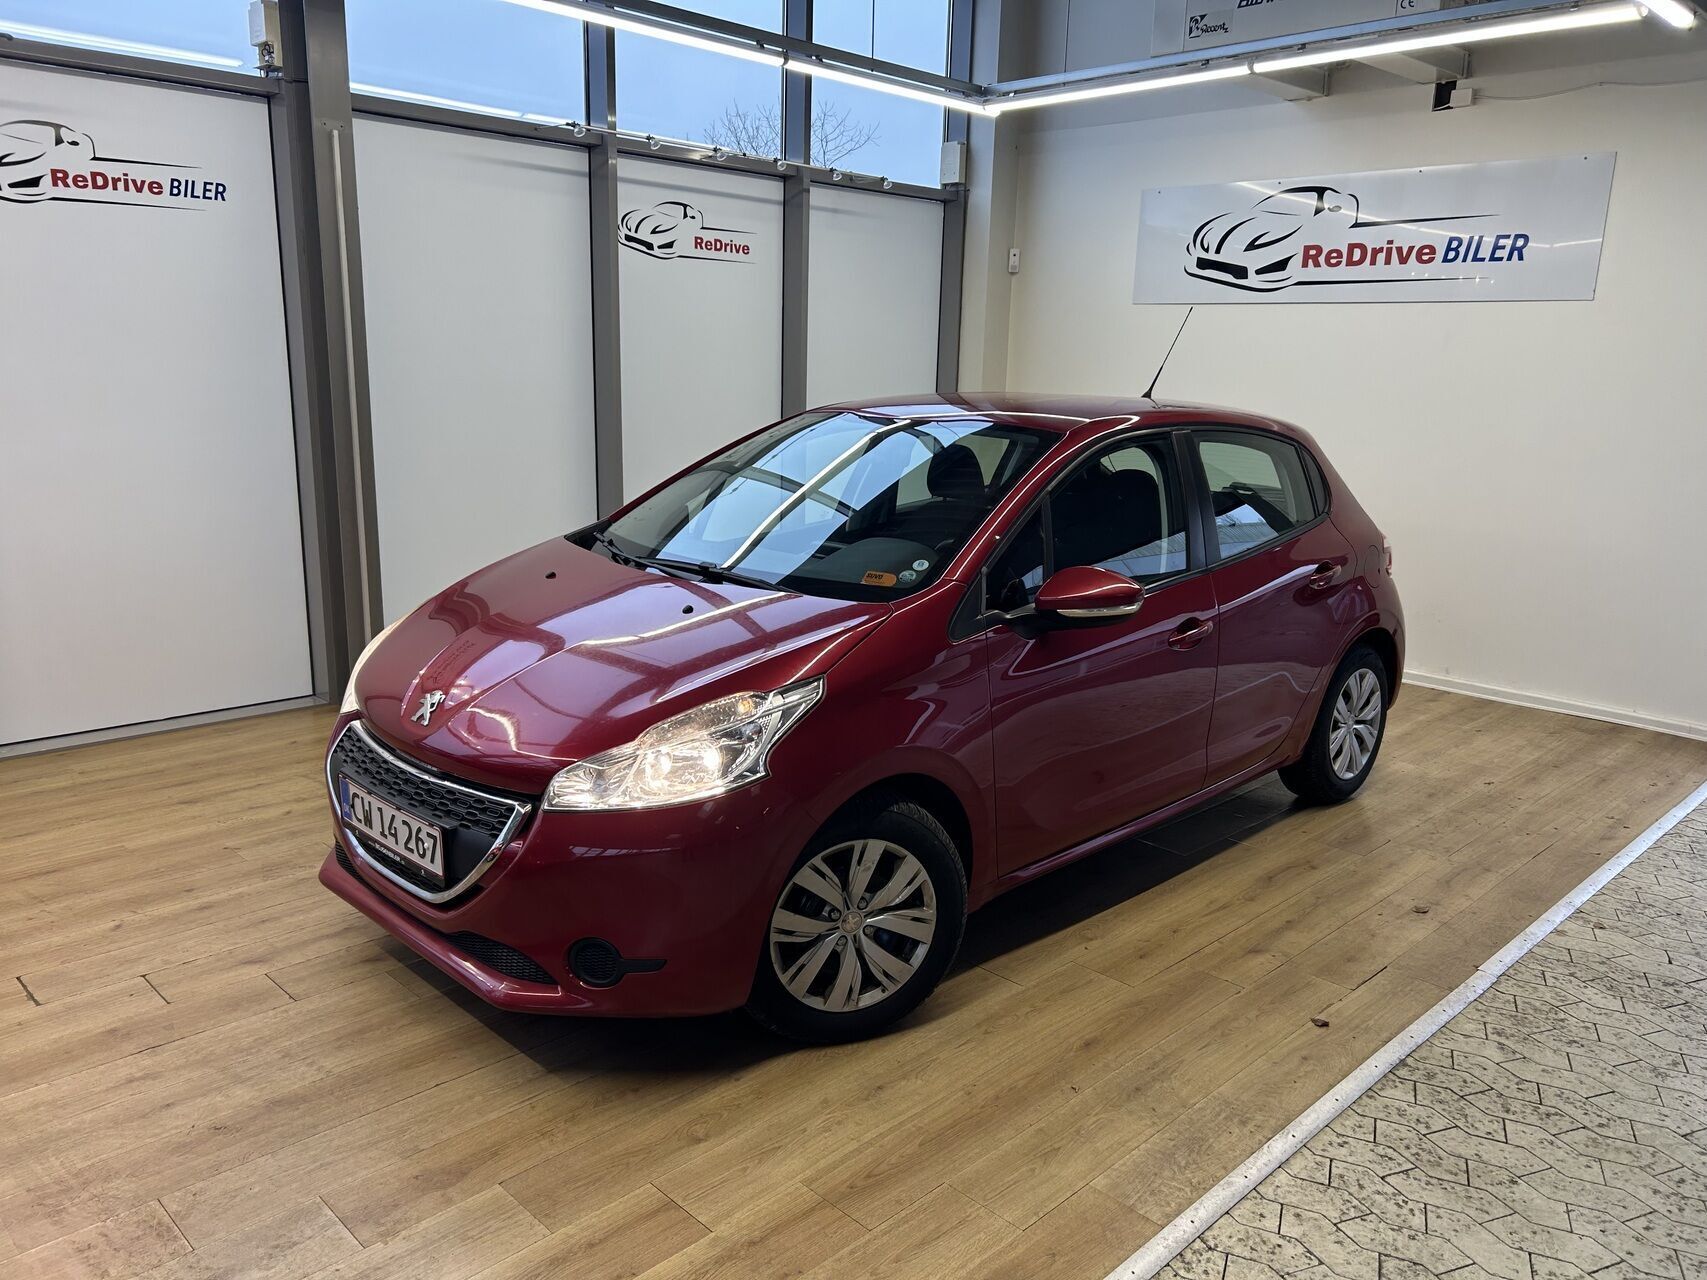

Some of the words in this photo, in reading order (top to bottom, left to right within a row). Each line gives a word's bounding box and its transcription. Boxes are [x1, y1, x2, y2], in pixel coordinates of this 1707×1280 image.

[50, 168, 164, 196] ReDrive
[169, 177, 227, 202] BILER
[694, 236, 751, 255] ReDrive
[1301, 239, 1437, 268] ReDrive
[1441, 233, 1530, 264] BILER
[351, 791, 373, 831] CW
[377, 806, 399, 846] 14
[401, 819, 438, 865] 267
